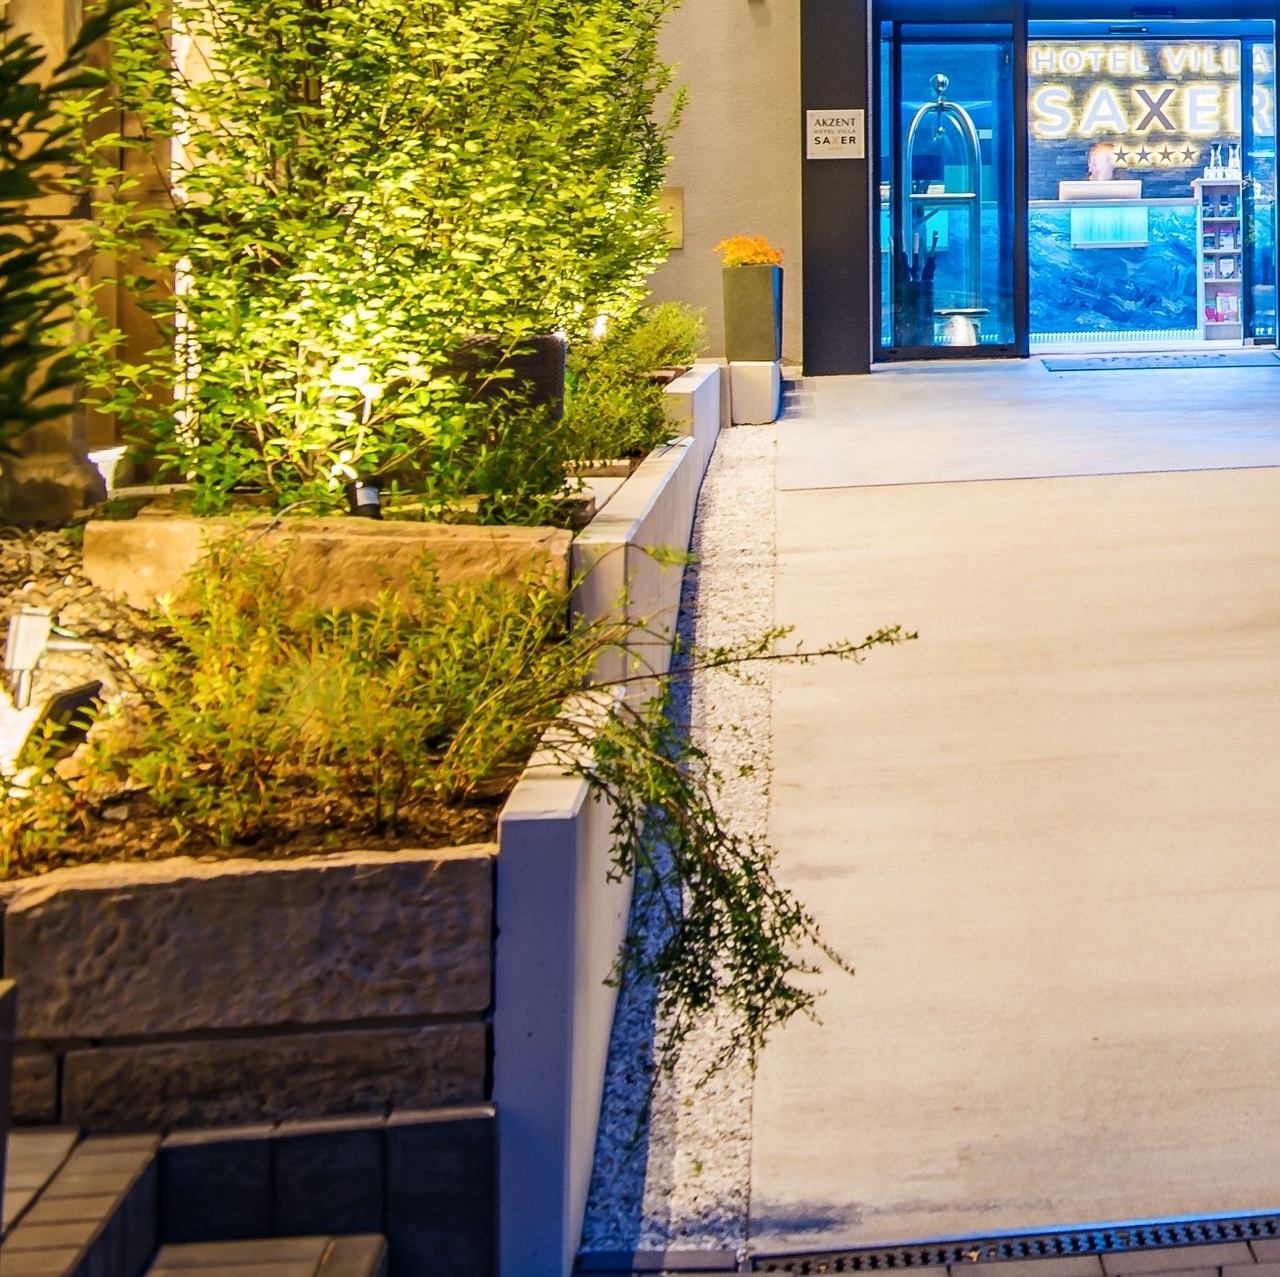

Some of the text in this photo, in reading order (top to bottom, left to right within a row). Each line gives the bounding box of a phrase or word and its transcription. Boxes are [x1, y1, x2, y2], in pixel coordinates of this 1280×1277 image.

[1034, 49, 1271, 72] HOTEL VILLA
[1036, 88, 1270, 134] SAXER
[814, 117, 856, 127] AKZENT
[814, 136, 856, 145] SAXER
